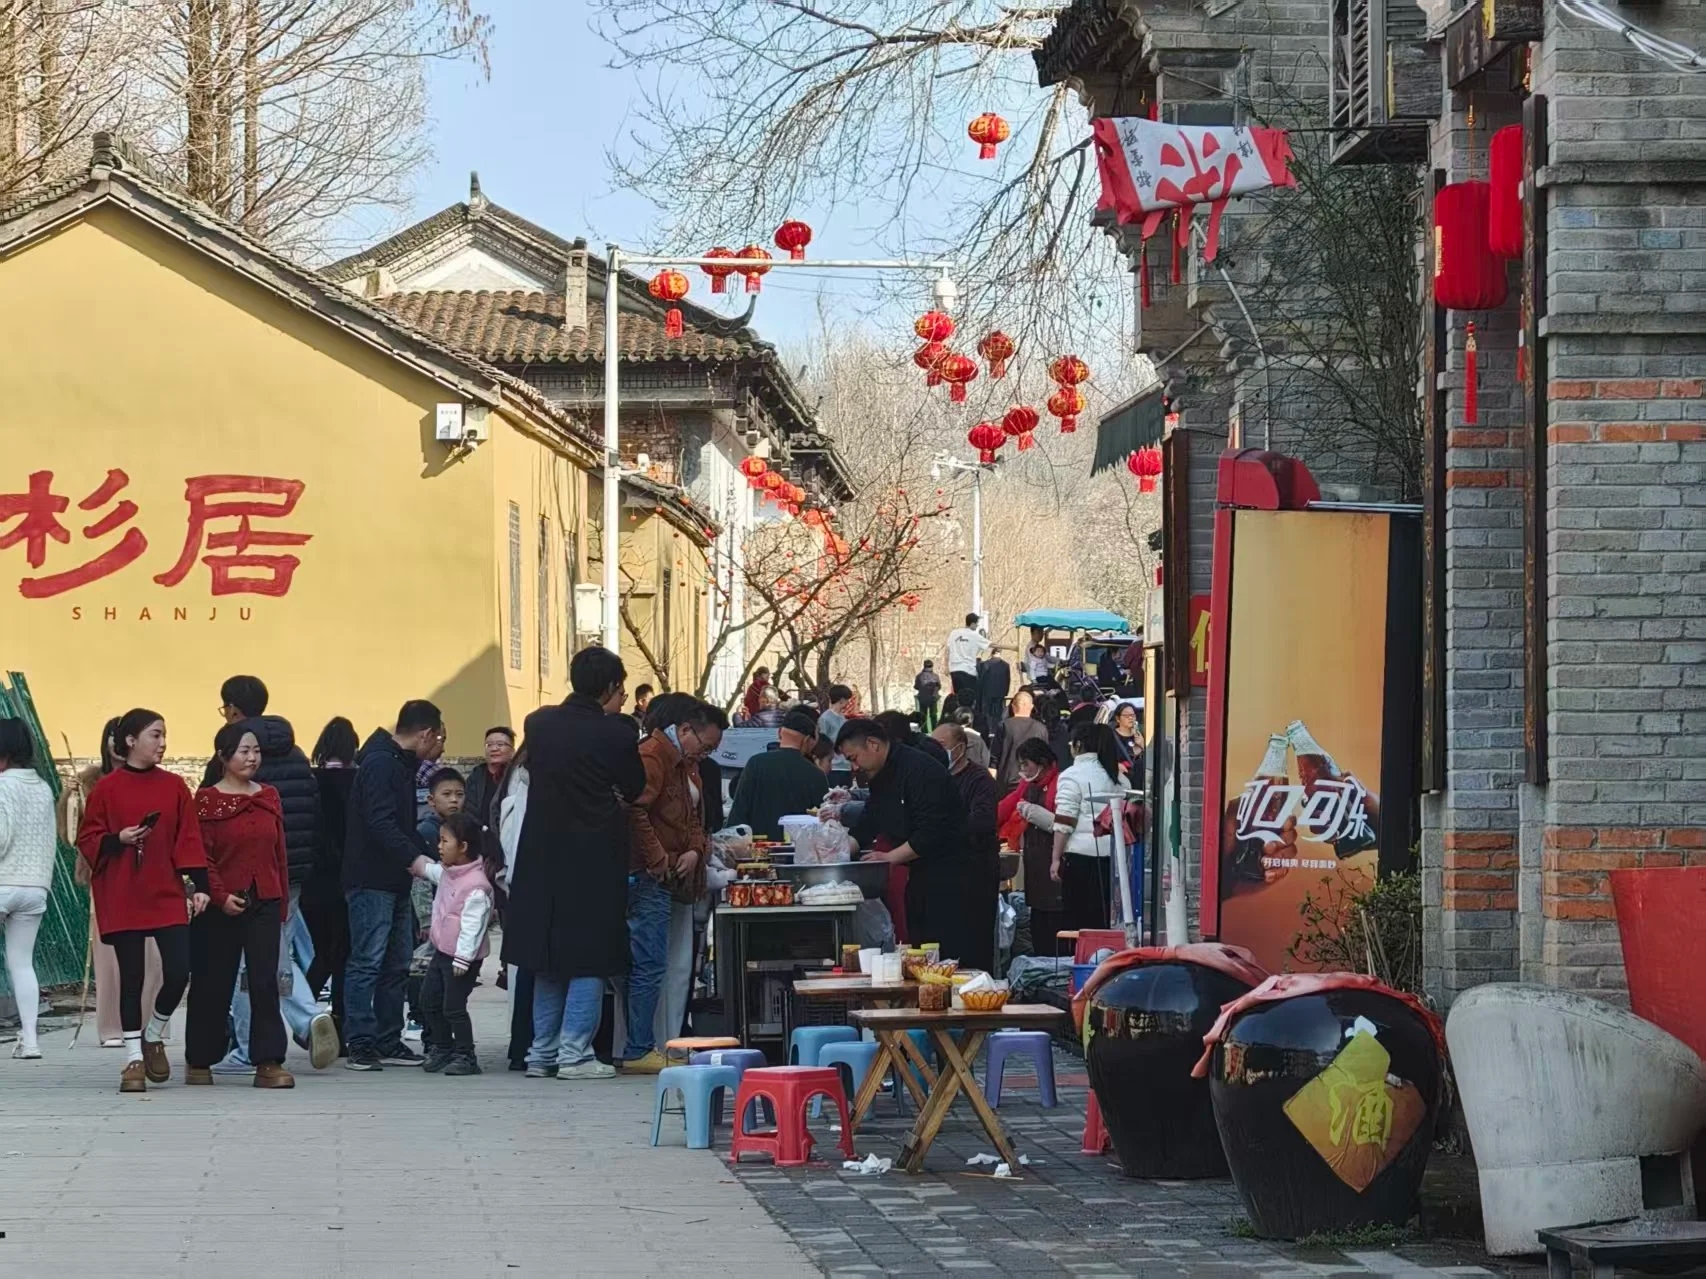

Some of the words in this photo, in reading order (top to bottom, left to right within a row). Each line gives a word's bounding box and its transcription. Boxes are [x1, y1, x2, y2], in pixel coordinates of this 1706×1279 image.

[0, 468, 313, 598] 杉居
[72, 606, 253, 621] SHANJU
[1236, 776, 1376, 845] 可口可乐
